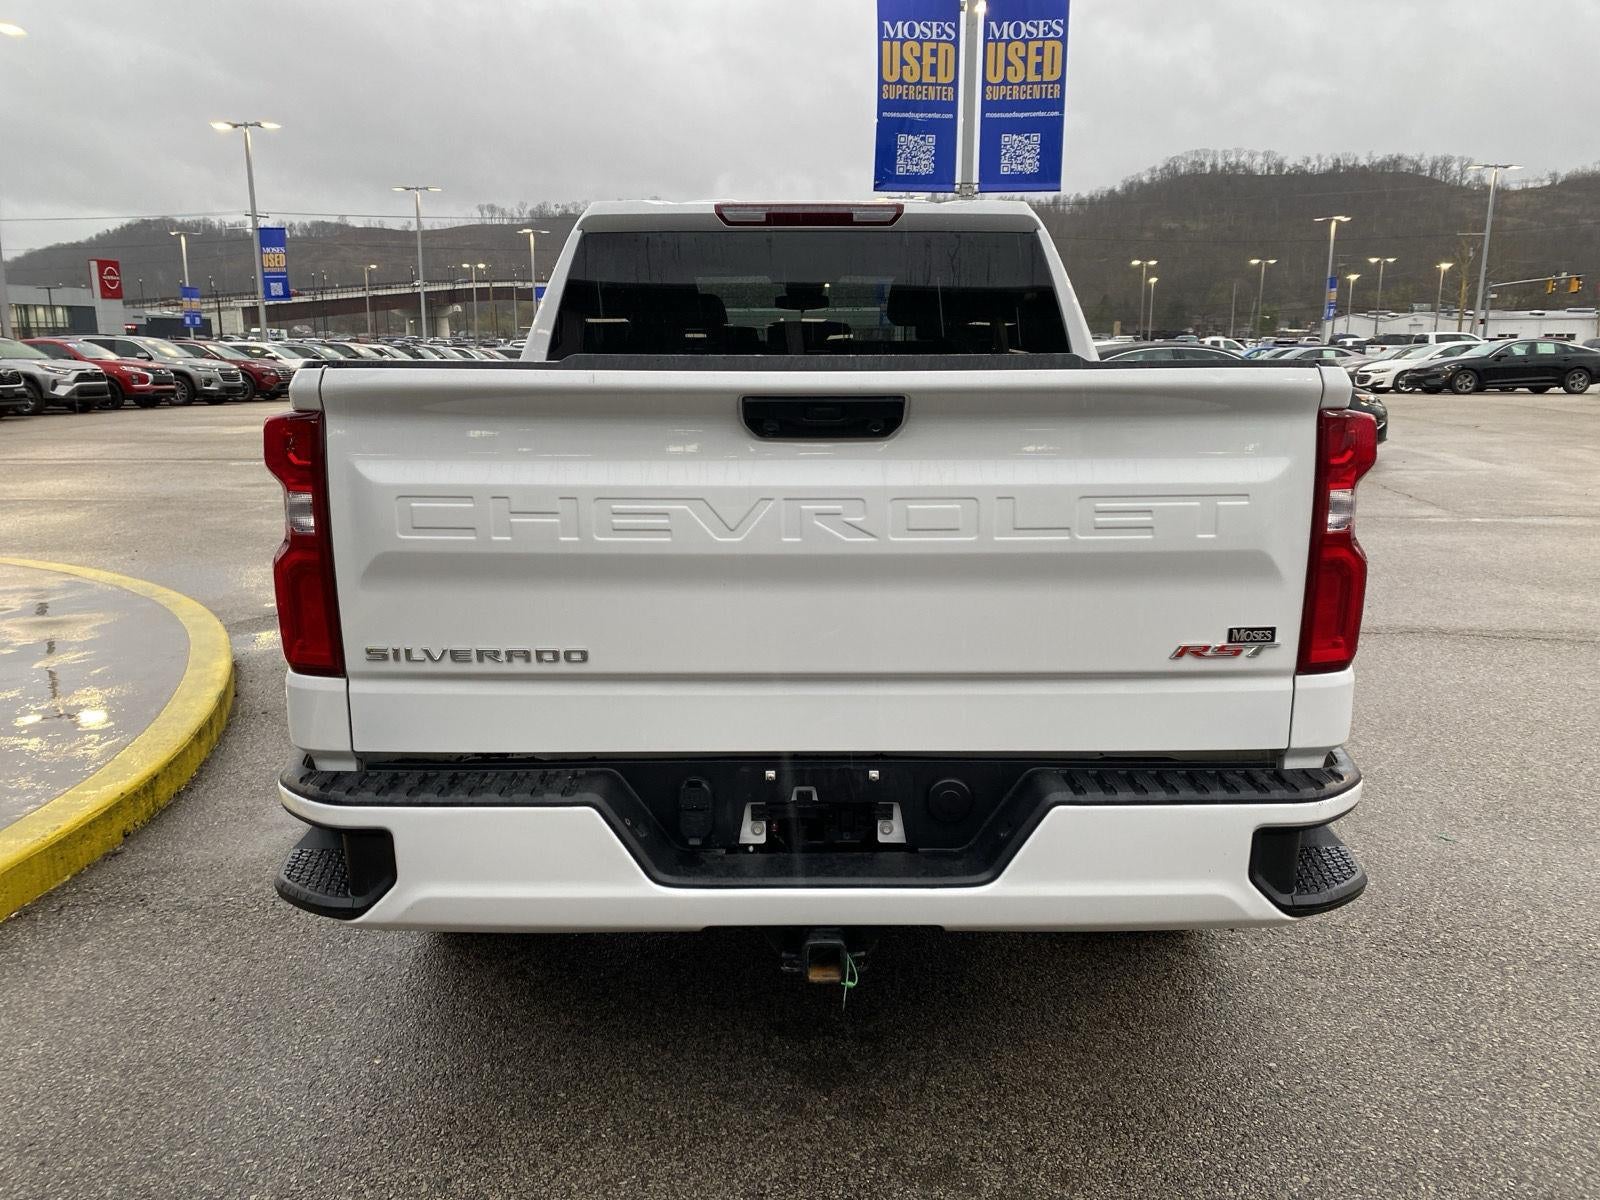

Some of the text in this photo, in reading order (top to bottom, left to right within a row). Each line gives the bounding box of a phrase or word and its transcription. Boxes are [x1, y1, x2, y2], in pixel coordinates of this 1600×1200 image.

[883, 21, 955, 40] MOSES
[989, 19, 1064, 40] MOSES
[882, 41, 955, 83] USED
[986, 41, 1063, 84] USED
[882, 84, 954, 101] SUPERCENTER
[986, 84, 1060, 101] SUPERCENTER
[882, 111, 953, 119] mosesusedsupercenter.com
[985, 110, 1060, 119] mosesusedsupercenter.com
[262, 253, 286, 268] USED
[396, 494, 1250, 542] CHEVROLET
[1231, 628, 1273, 642] MOSES
[365, 647, 589, 663] SILVERADO
[1168, 643, 1281, 661] RST
